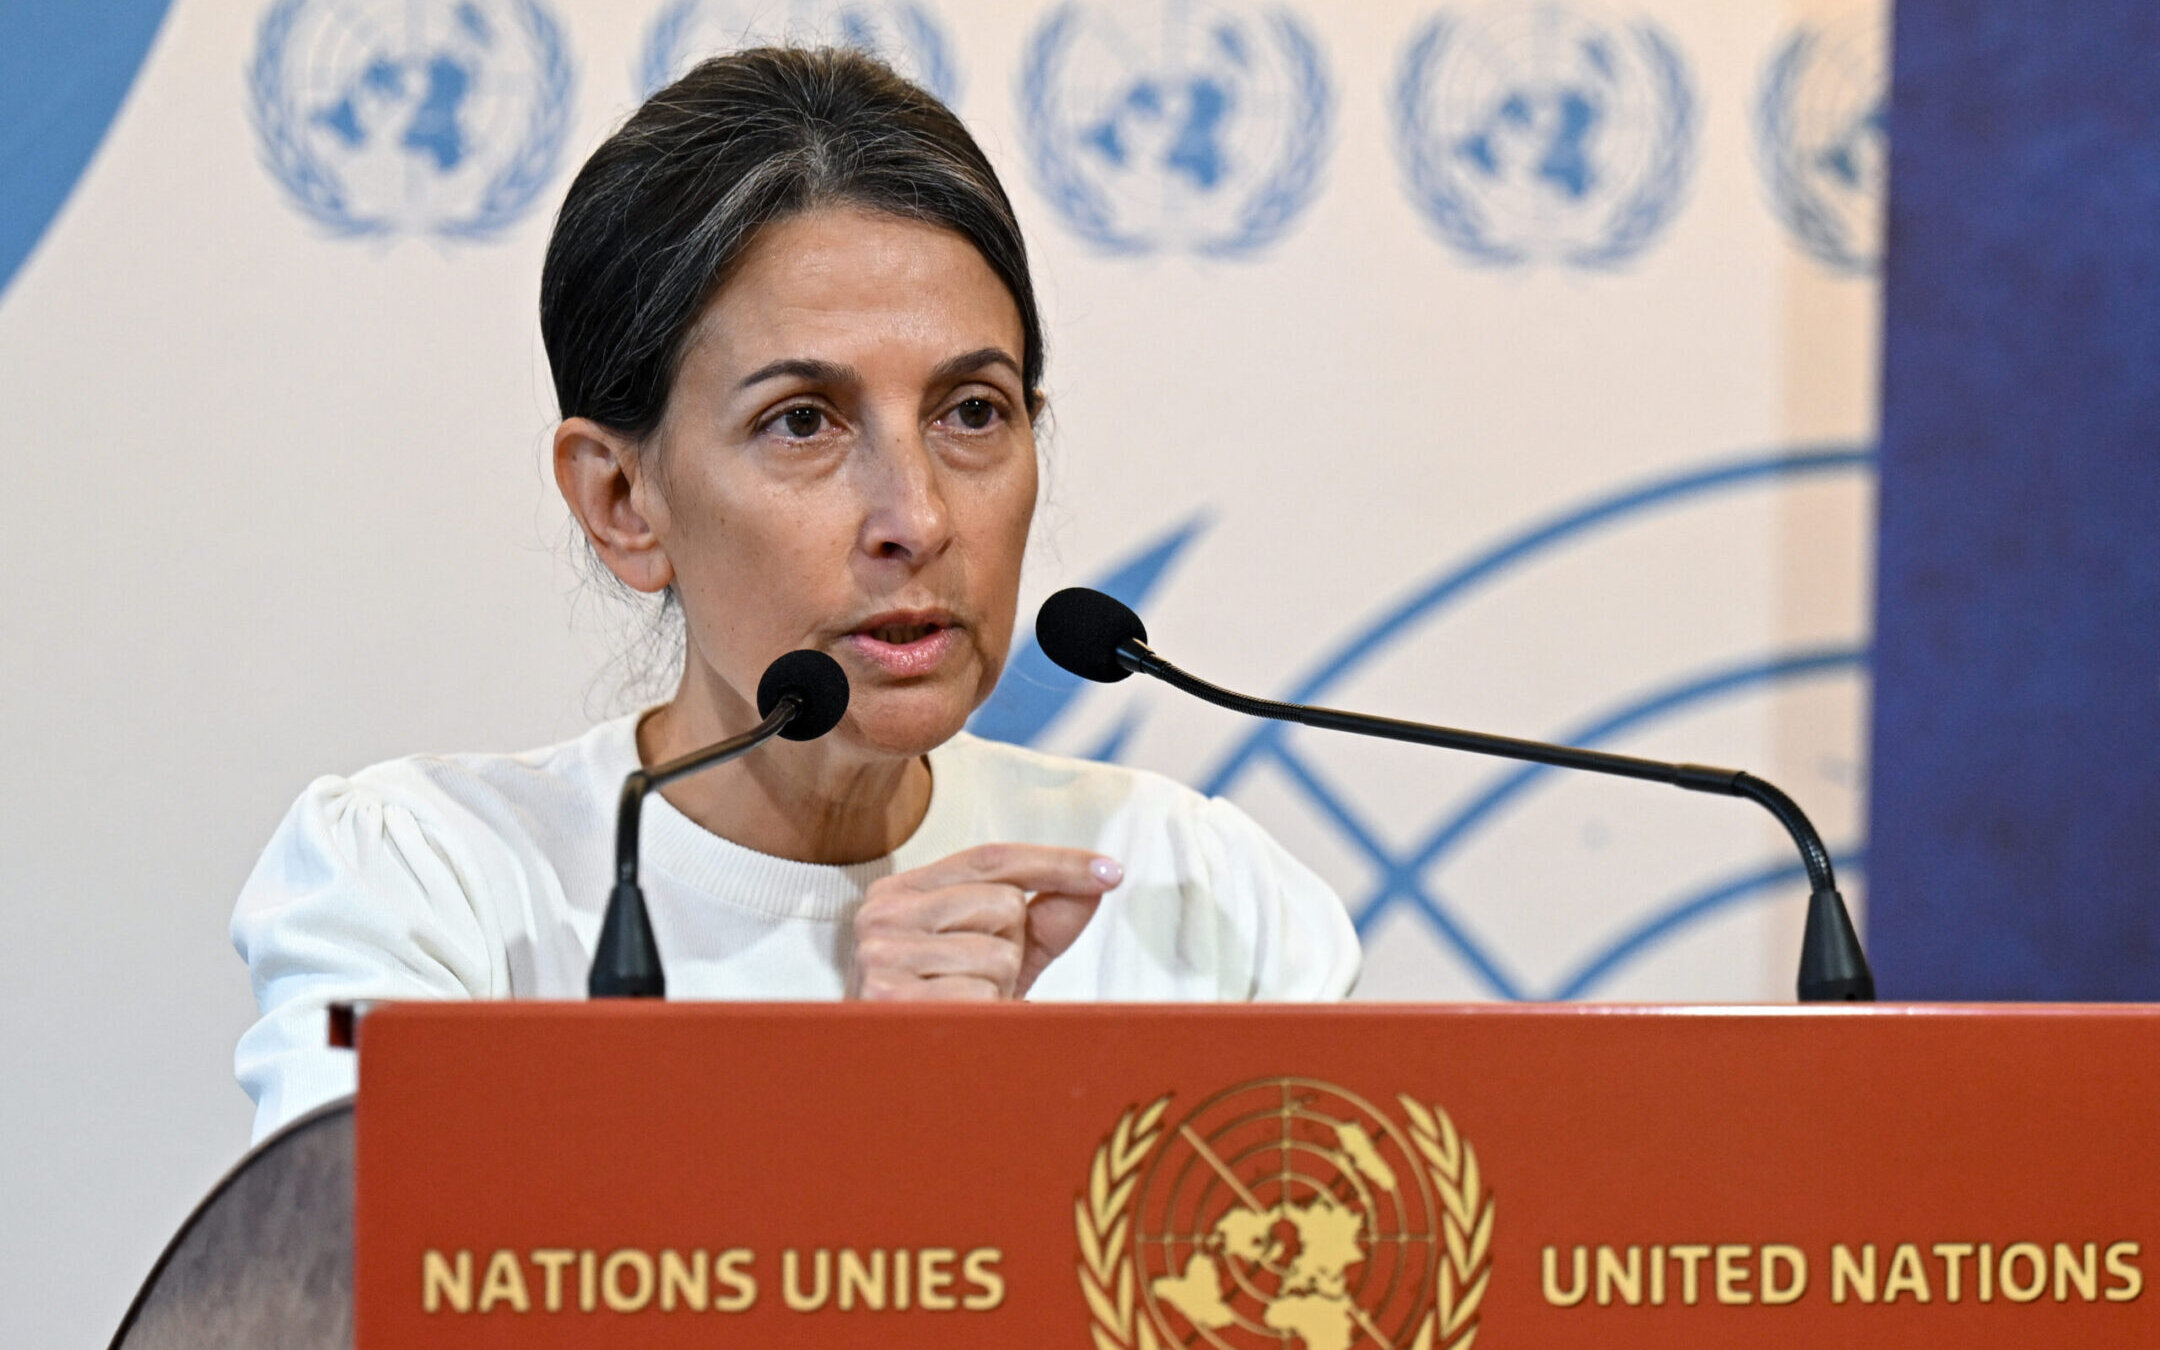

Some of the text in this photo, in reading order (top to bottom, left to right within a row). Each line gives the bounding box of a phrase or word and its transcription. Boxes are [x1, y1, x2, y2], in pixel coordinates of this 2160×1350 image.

[424, 1249, 1005, 1312] NATIONS UNIES
[1543, 1242, 2143, 1306] UNITED NATIONS
